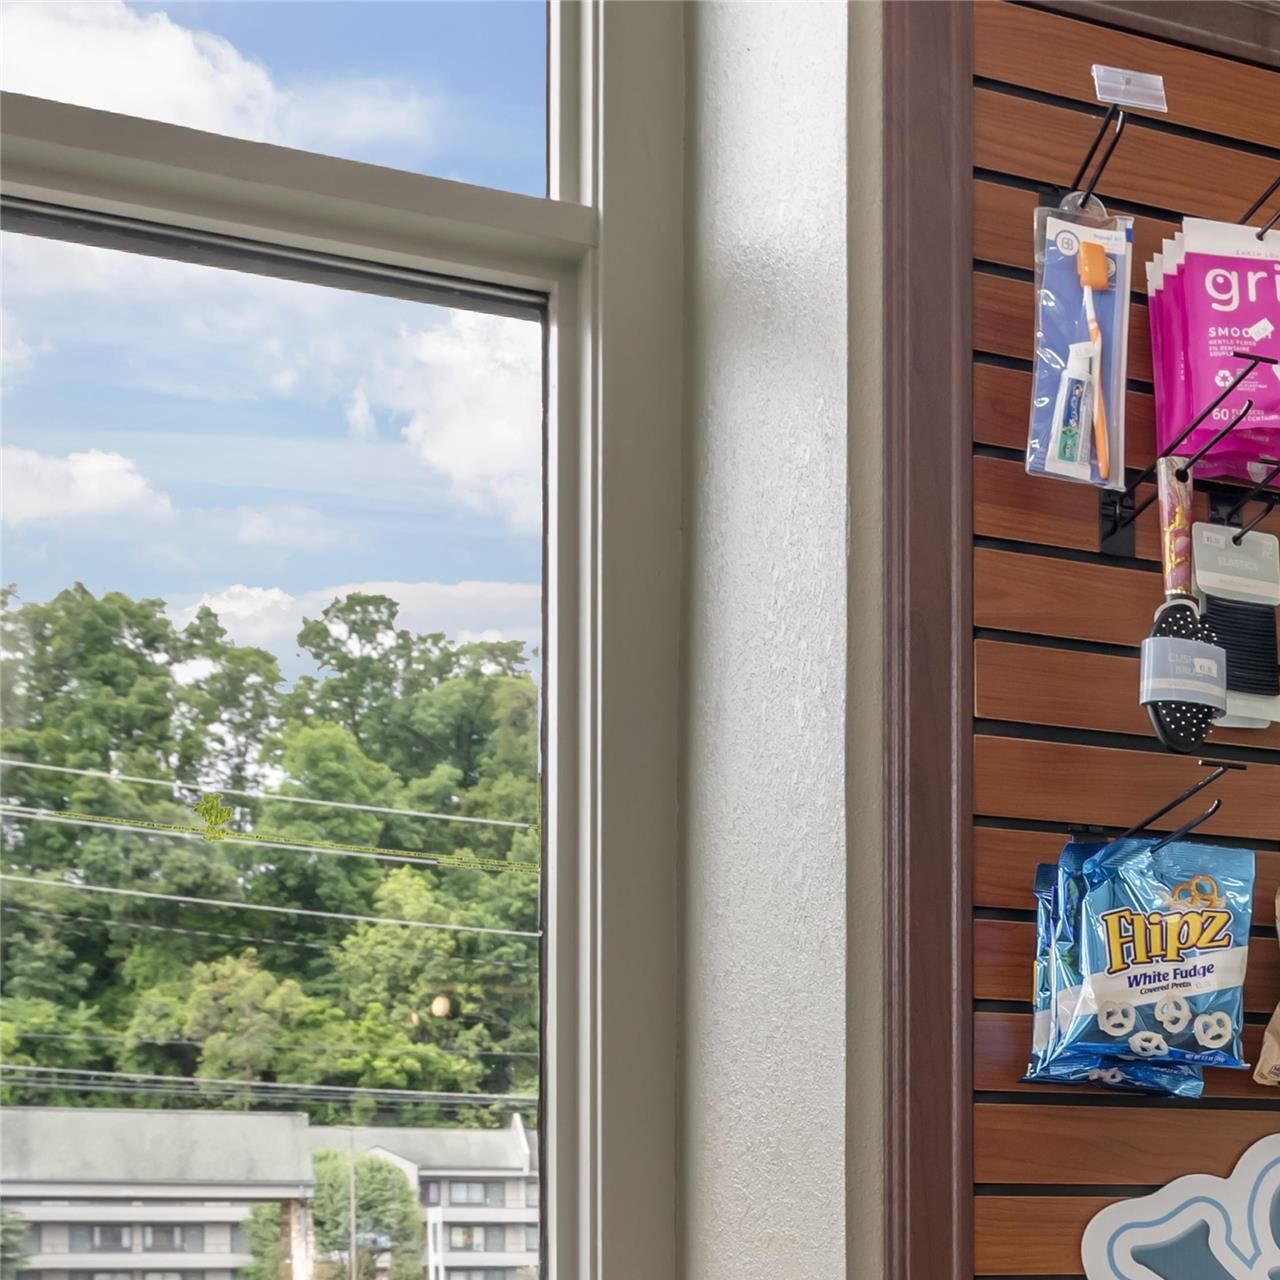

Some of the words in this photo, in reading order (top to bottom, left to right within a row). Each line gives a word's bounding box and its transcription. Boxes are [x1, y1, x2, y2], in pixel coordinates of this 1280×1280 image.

[1212, 408, 1230, 421] 60
[1103, 906, 1233, 975] Flipz
[1127, 970, 1170, 989] White
[1172, 962, 1216, 982] Fudge
[1139, 983, 1171, 995] Covered
